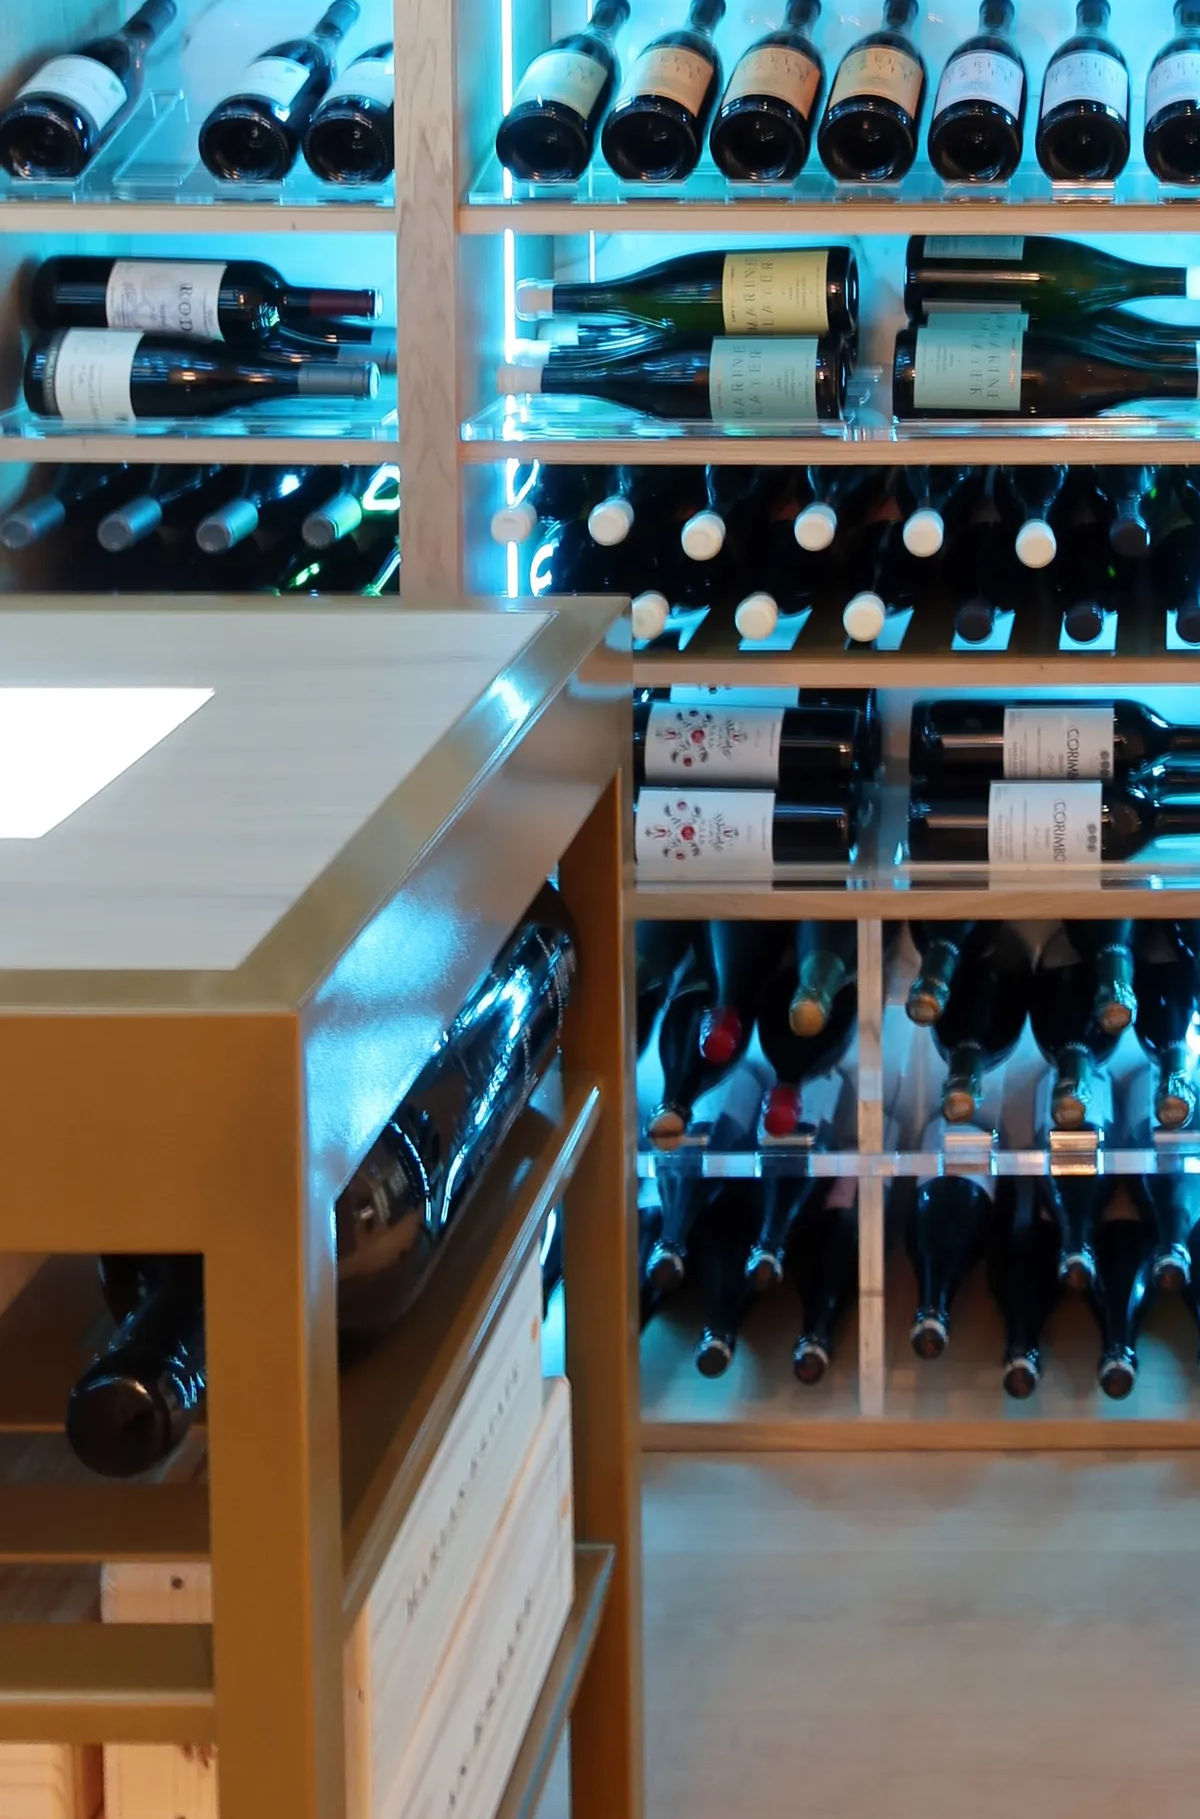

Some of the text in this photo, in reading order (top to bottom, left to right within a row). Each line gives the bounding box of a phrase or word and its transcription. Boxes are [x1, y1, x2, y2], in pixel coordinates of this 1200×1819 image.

[178, 283, 193, 332] ROD
[743, 257, 758, 332] MARINE
[761, 261, 775, 327] LAYER
[731, 344, 746, 419] MARINE
[748, 350, 762, 416] LAYER
[1053, 799, 1067, 862] CORIMBO
